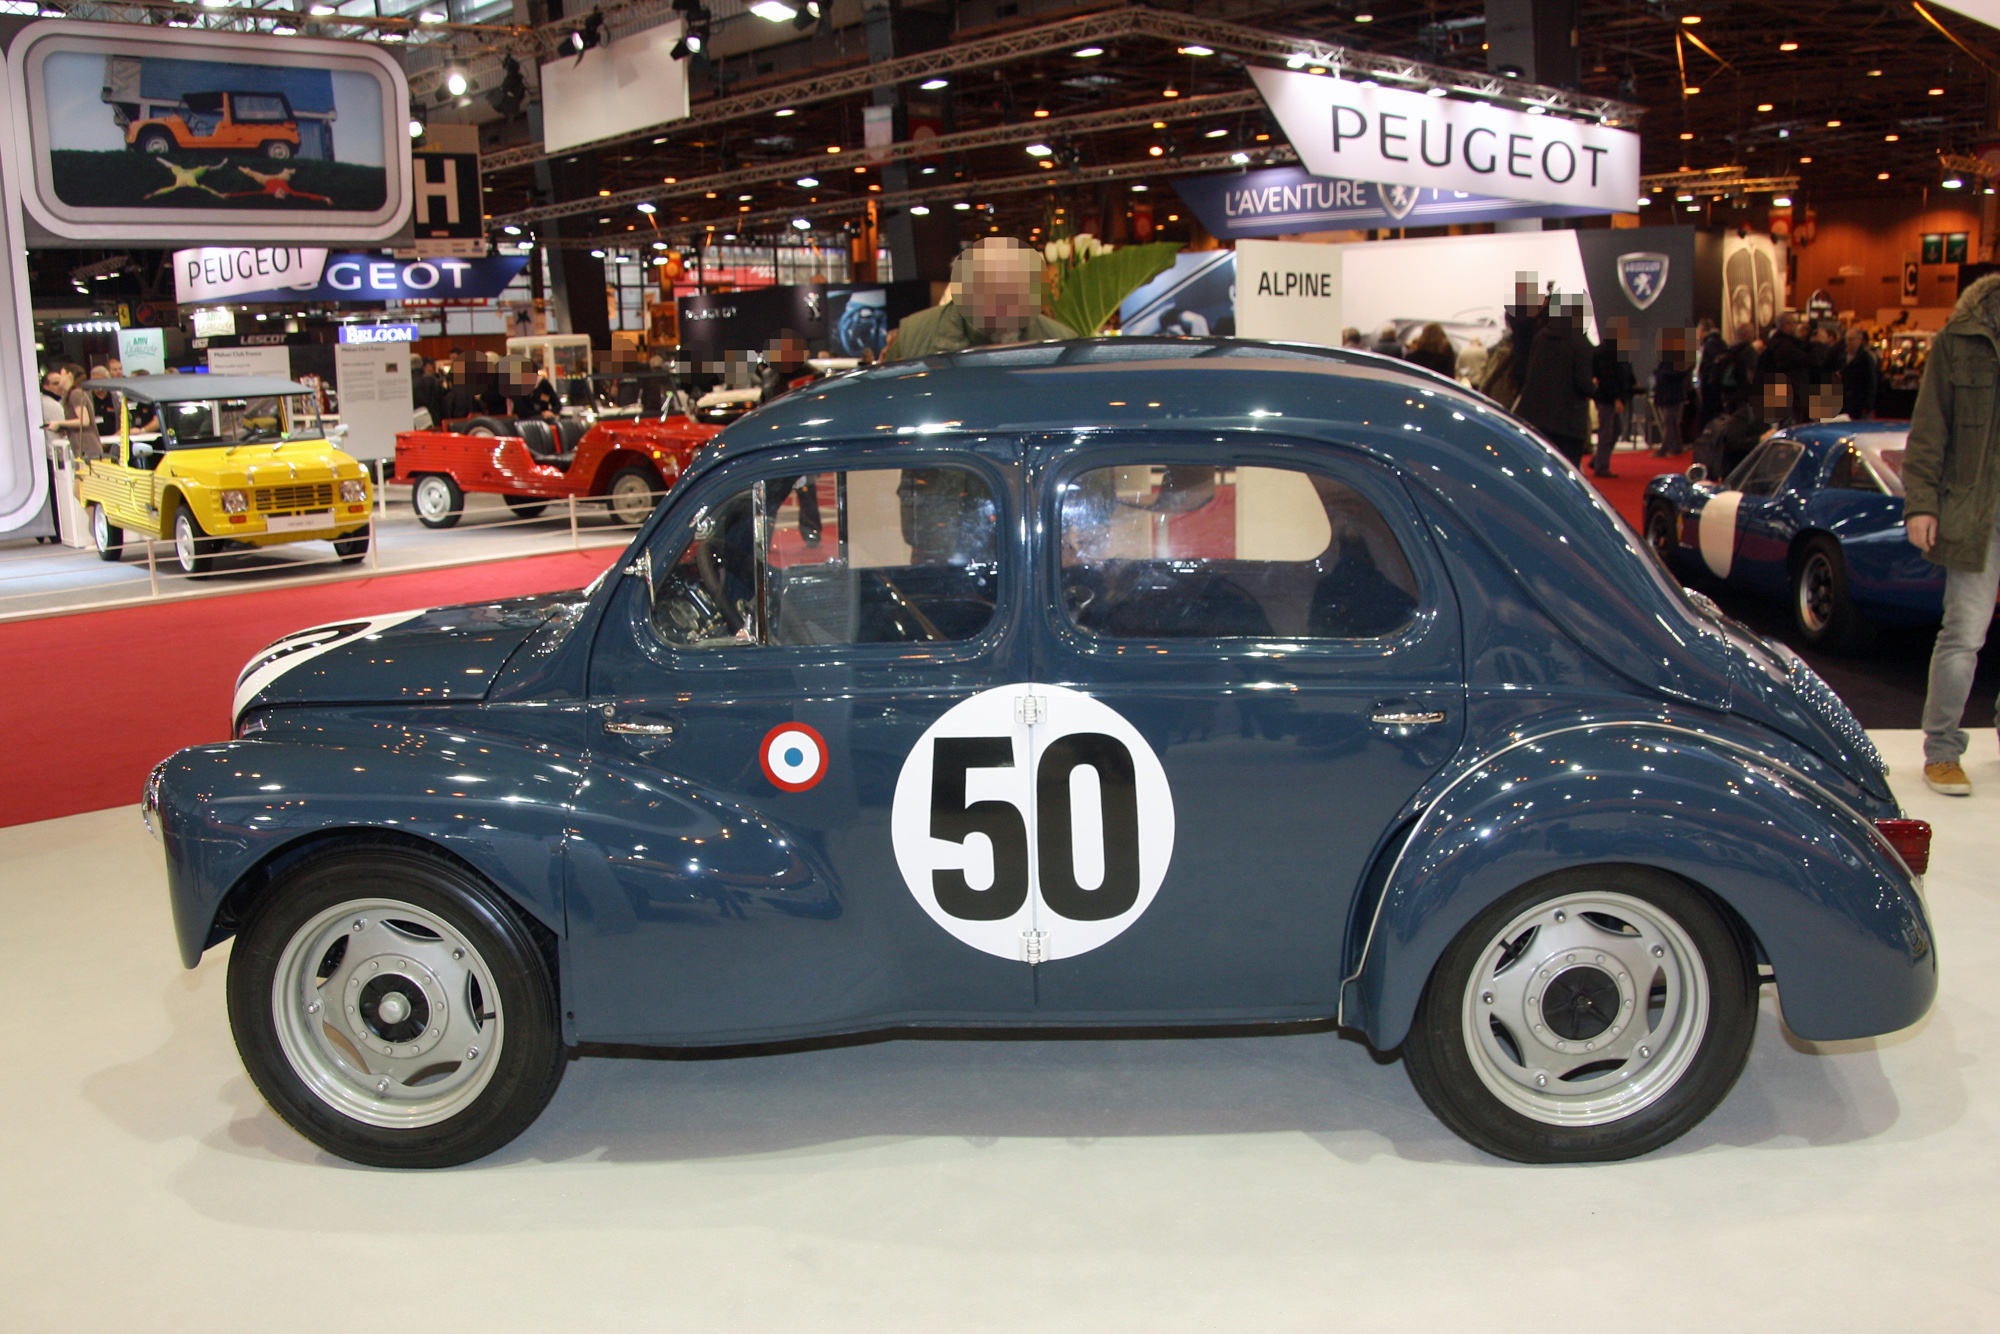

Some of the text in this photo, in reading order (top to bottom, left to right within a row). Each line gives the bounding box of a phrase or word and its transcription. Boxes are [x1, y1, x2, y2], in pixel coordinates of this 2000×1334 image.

[1331, 104, 1609, 188] PEUGEOT
[413, 158, 460, 224] H
[1225, 180, 1367, 216] L'AVENTURE
[1257, 271, 1332, 297] ALPINE
[240, 334, 288, 345] LESCOT
[929, 732, 1141, 922] 50
